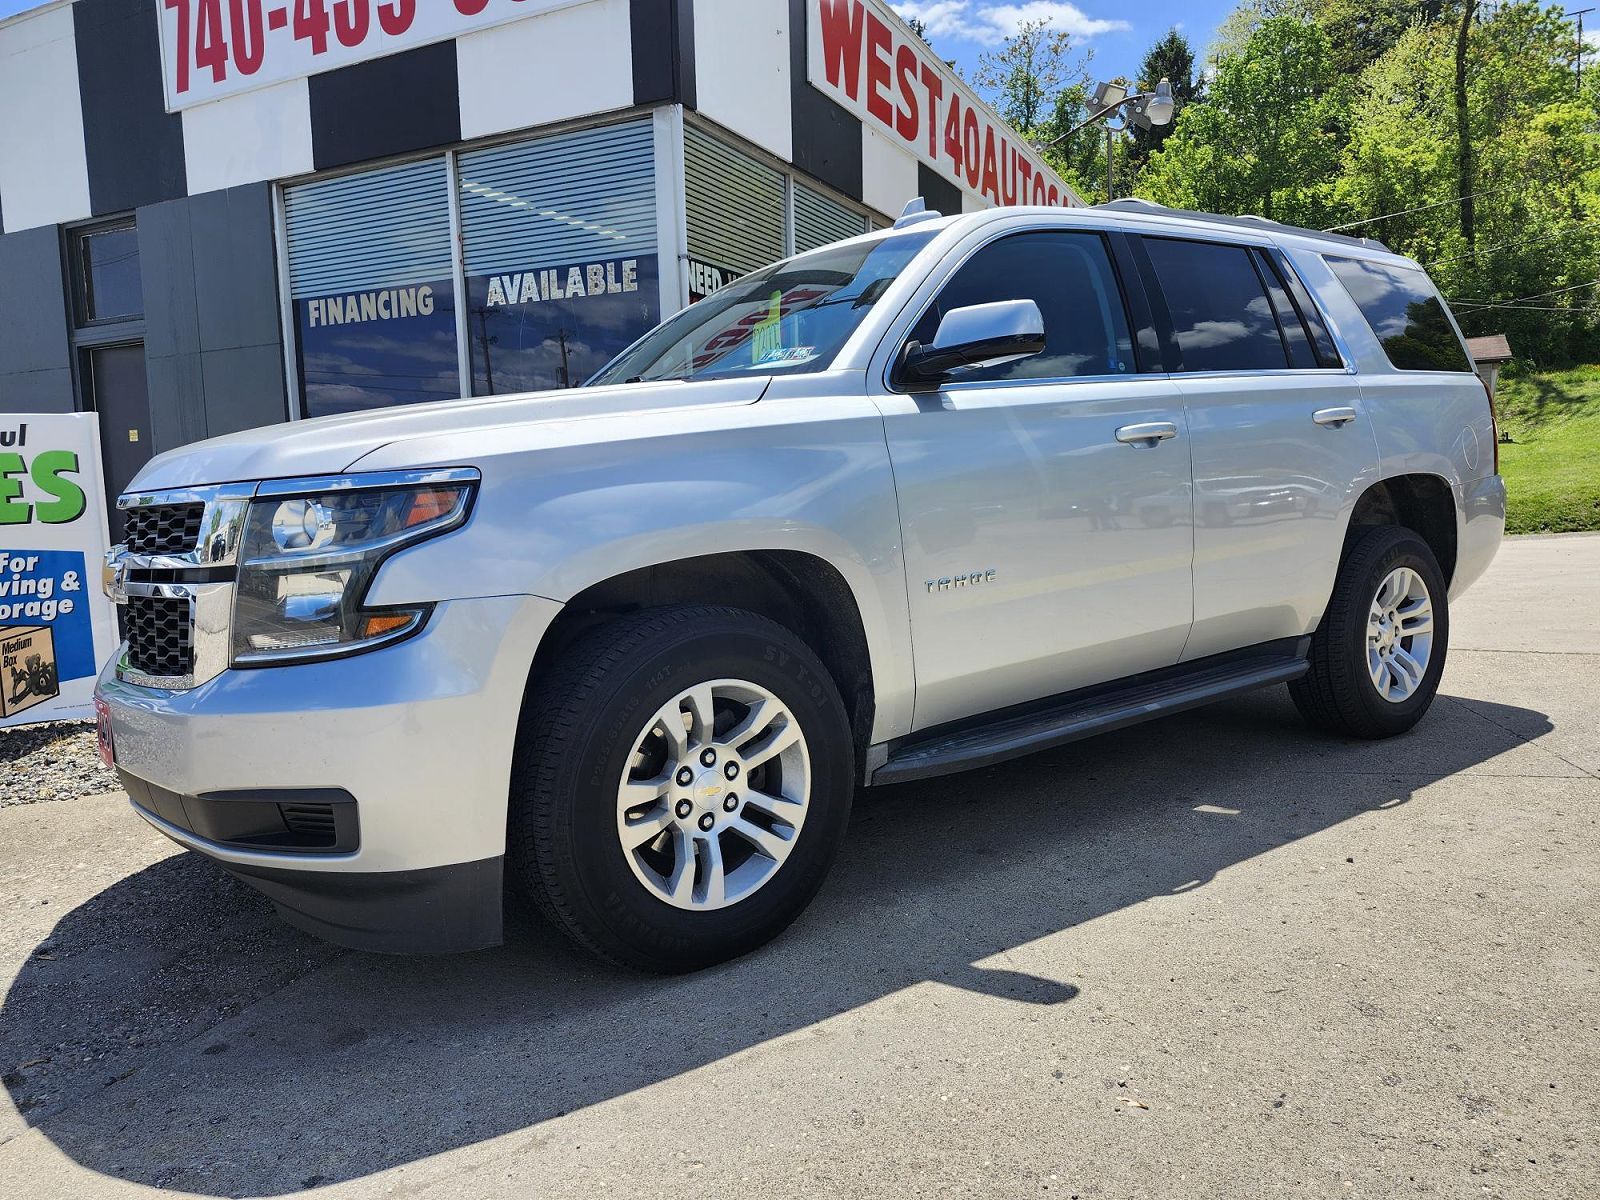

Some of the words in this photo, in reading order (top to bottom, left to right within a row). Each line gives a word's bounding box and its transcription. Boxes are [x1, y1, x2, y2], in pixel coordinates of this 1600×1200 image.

[688, 260, 723, 296] NEED
[309, 285, 435, 328] FINANCING
[486, 259, 639, 307] AVAILABLE
[60, 570, 81, 592] &
[924, 568, 997, 594] TAHOE
[2, 637, 32, 656] Medium
[3, 655, 18, 669] Box
